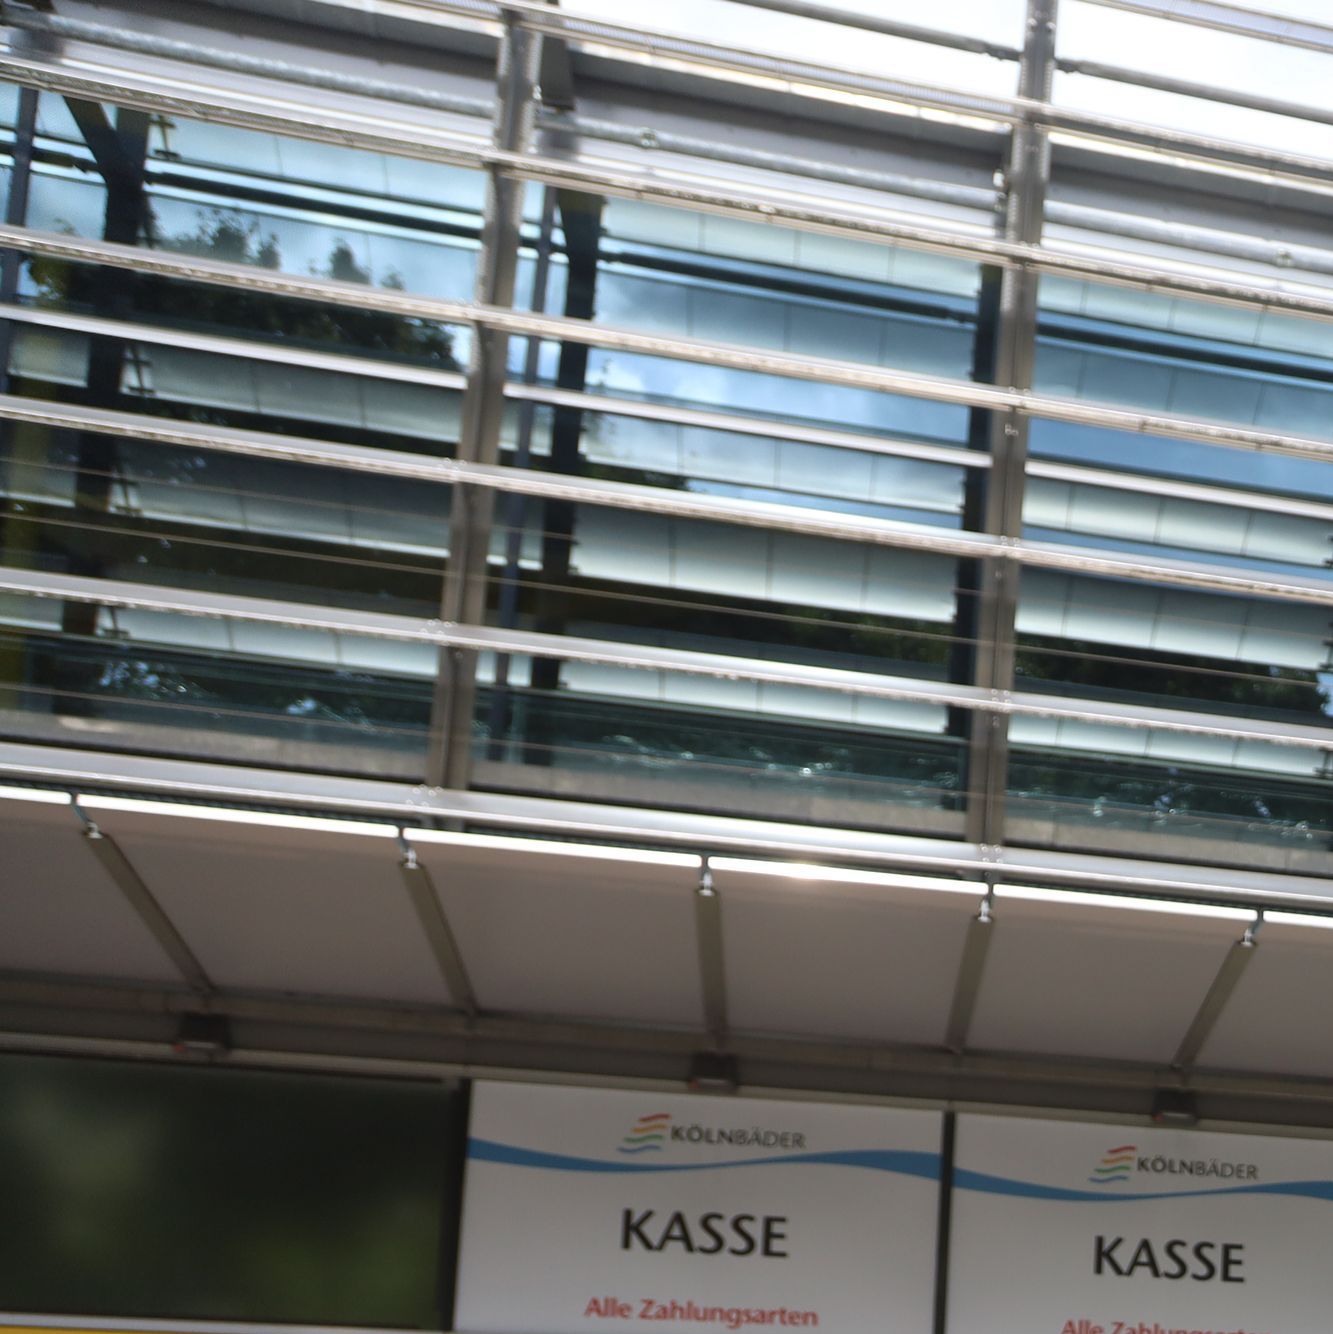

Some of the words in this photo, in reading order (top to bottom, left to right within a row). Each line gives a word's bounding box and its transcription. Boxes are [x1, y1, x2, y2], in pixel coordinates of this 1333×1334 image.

[670, 1123, 805, 1149] KÖLNBÄDER
[1136, 1154, 1259, 1180] KÖLNBÄDER
[621, 1207, 789, 1258] KASSE
[1094, 1236, 1245, 1283] KASSE
[584, 1296, 630, 1320] Alle
[638, 1298, 818, 1330] Zahlungsarten
